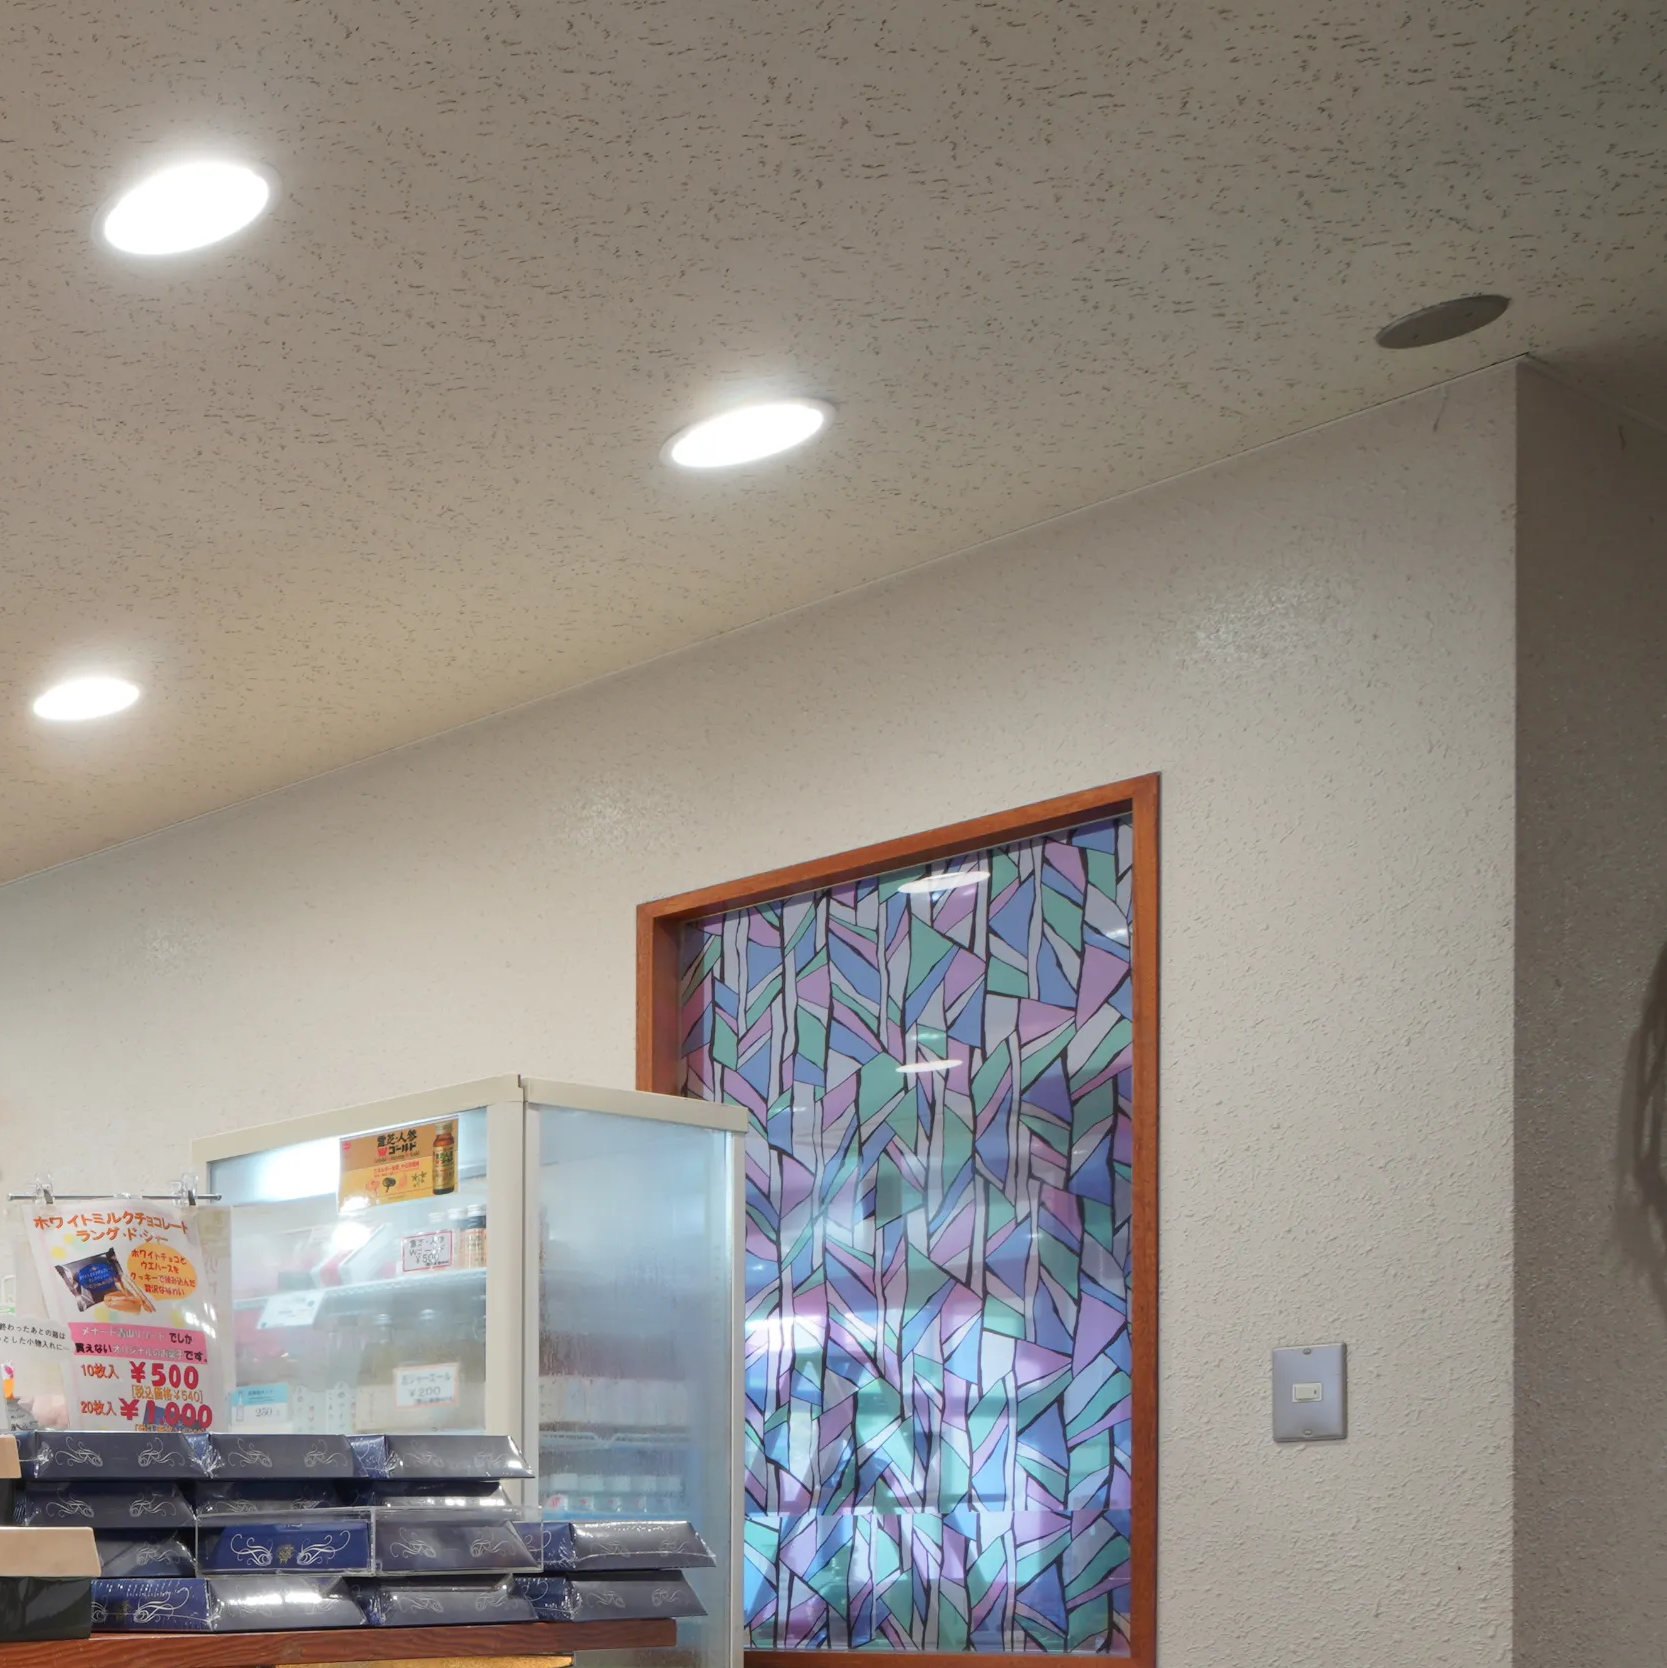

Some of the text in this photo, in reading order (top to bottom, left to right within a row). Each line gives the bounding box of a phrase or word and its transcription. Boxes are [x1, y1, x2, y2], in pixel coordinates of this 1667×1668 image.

[33, 1210, 188, 1235] ホワイトミルクチョコレート
[80, 1363, 120, 1379] 10枚入
